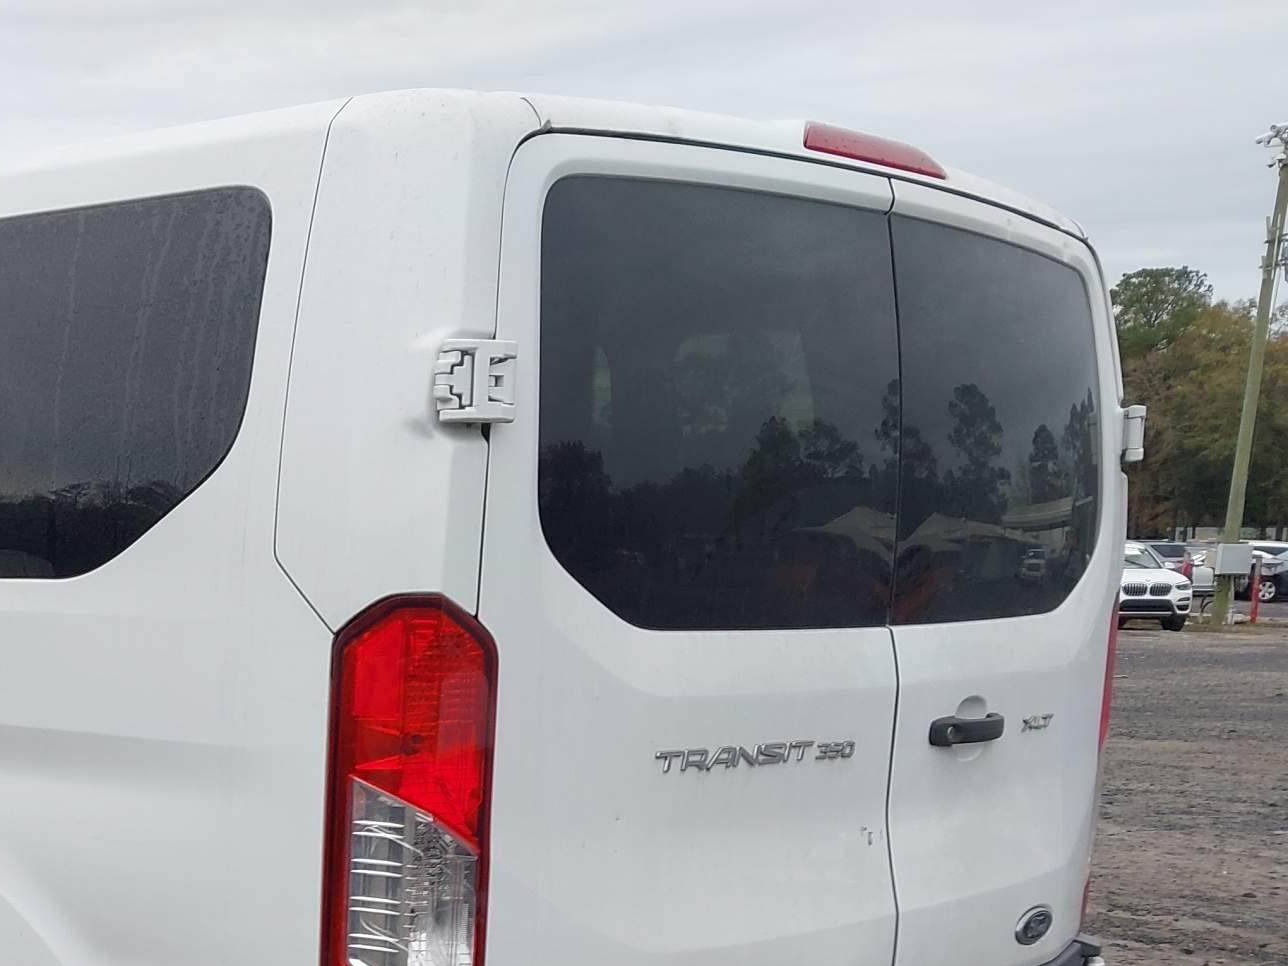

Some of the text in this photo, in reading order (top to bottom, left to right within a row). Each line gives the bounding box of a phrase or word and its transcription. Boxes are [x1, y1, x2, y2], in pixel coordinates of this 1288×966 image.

[1021, 713, 1054, 731] XLT
[655, 741, 856, 773] TRANSIT 350
